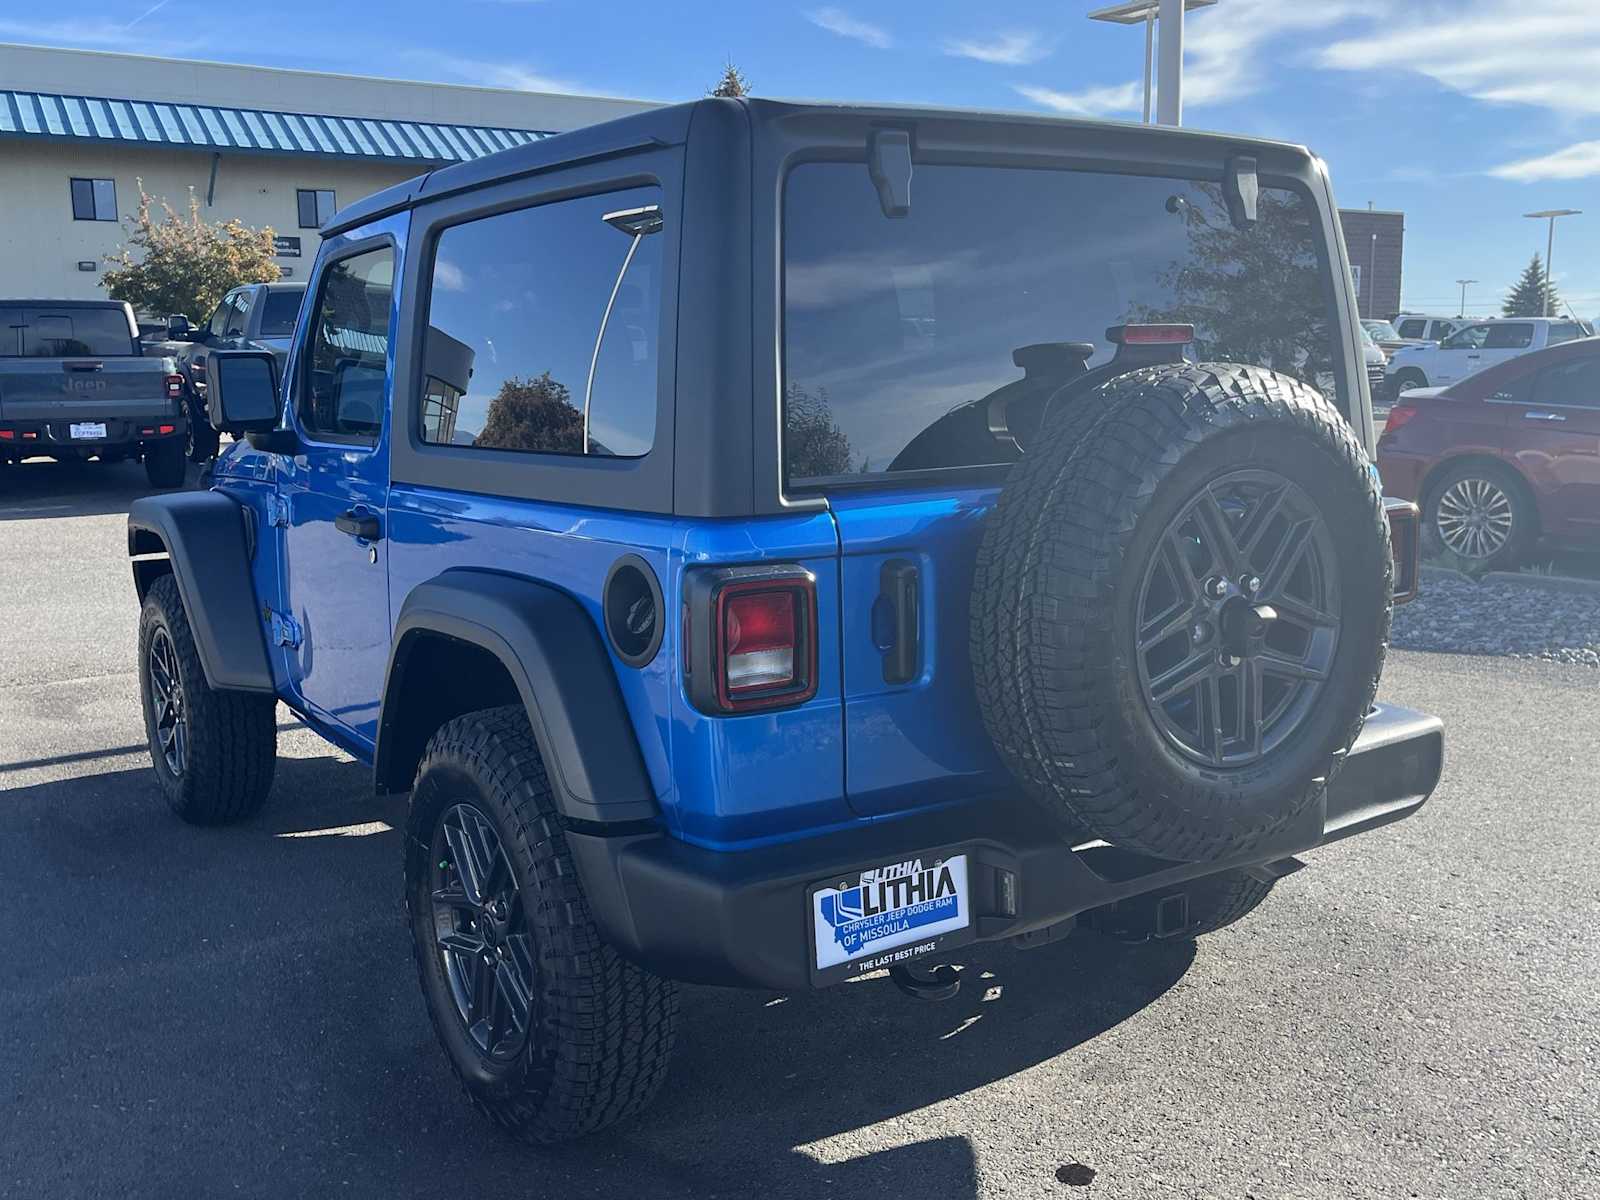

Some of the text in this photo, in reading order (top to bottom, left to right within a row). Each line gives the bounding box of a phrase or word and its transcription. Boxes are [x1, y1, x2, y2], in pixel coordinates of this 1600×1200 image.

[63, 376, 106, 393] Jeep
[873, 859, 923, 880] LITHIA
[863, 866, 957, 917] LITHIA
[842, 898, 953, 934] CHRYSLER JEEP DODGE RAM
[844, 921, 910, 947] OF MISSOULA
[859, 942, 936, 971] THE LAST BEST PRICE
